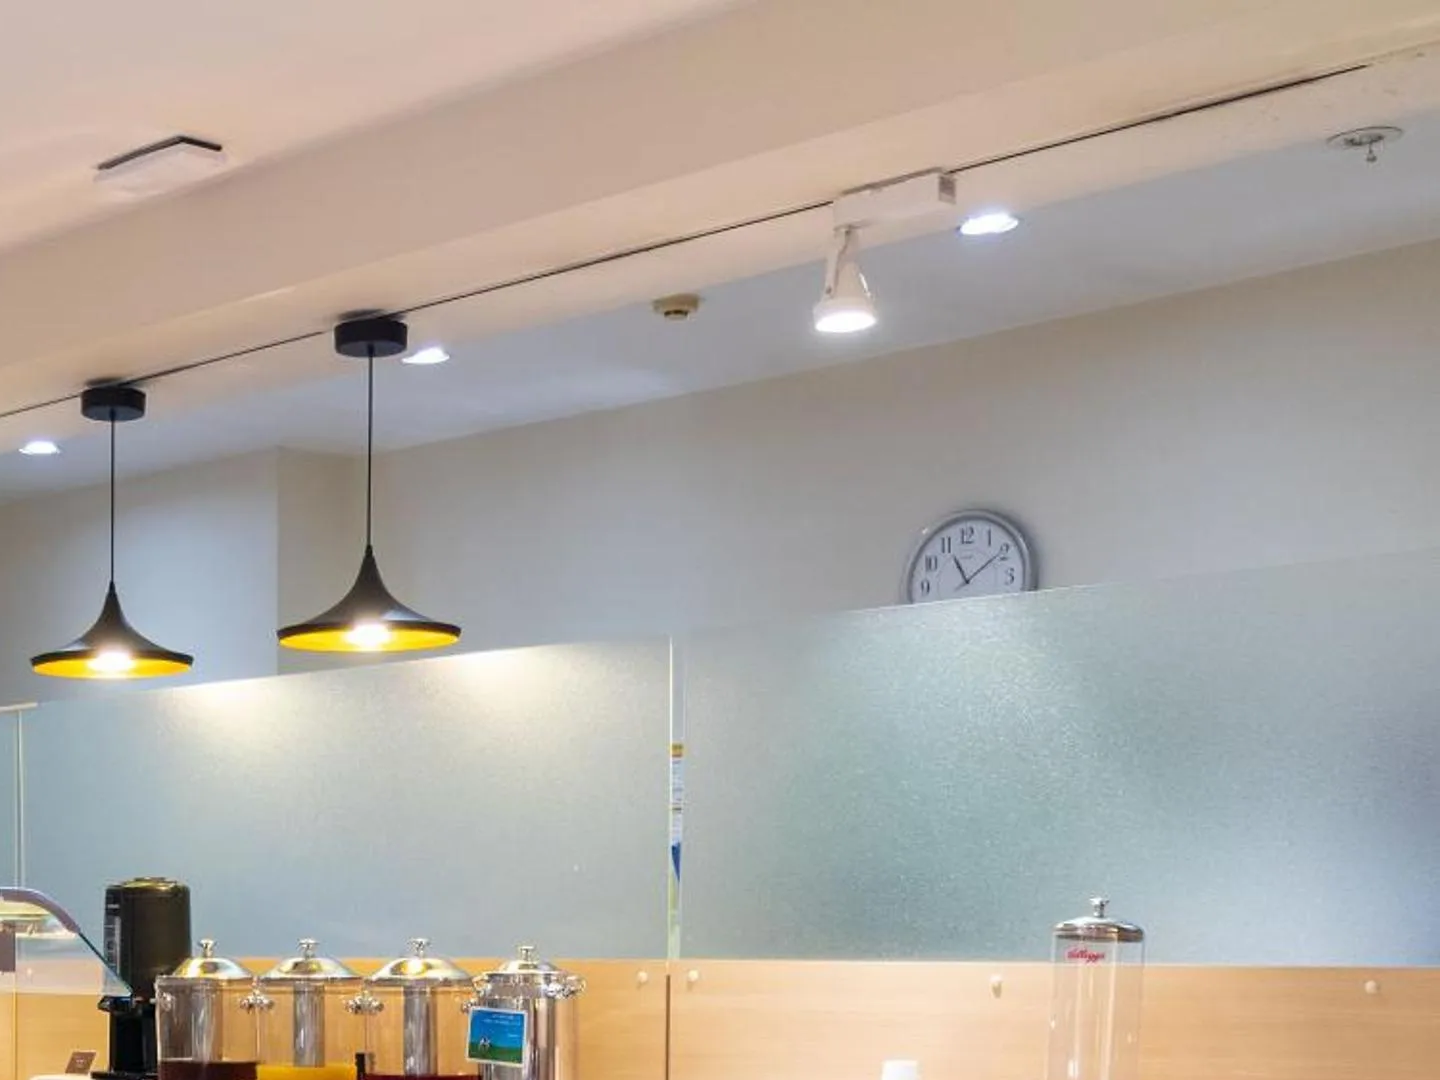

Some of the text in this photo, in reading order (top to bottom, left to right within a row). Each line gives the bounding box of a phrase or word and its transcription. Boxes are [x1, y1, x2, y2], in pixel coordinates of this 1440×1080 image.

[960, 526, 974, 544] 12
[940, 536, 951, 554] 11
[999, 542, 1010, 561] 2
[924, 555, 938, 572] 10
[921, 579, 930, 596] 9
